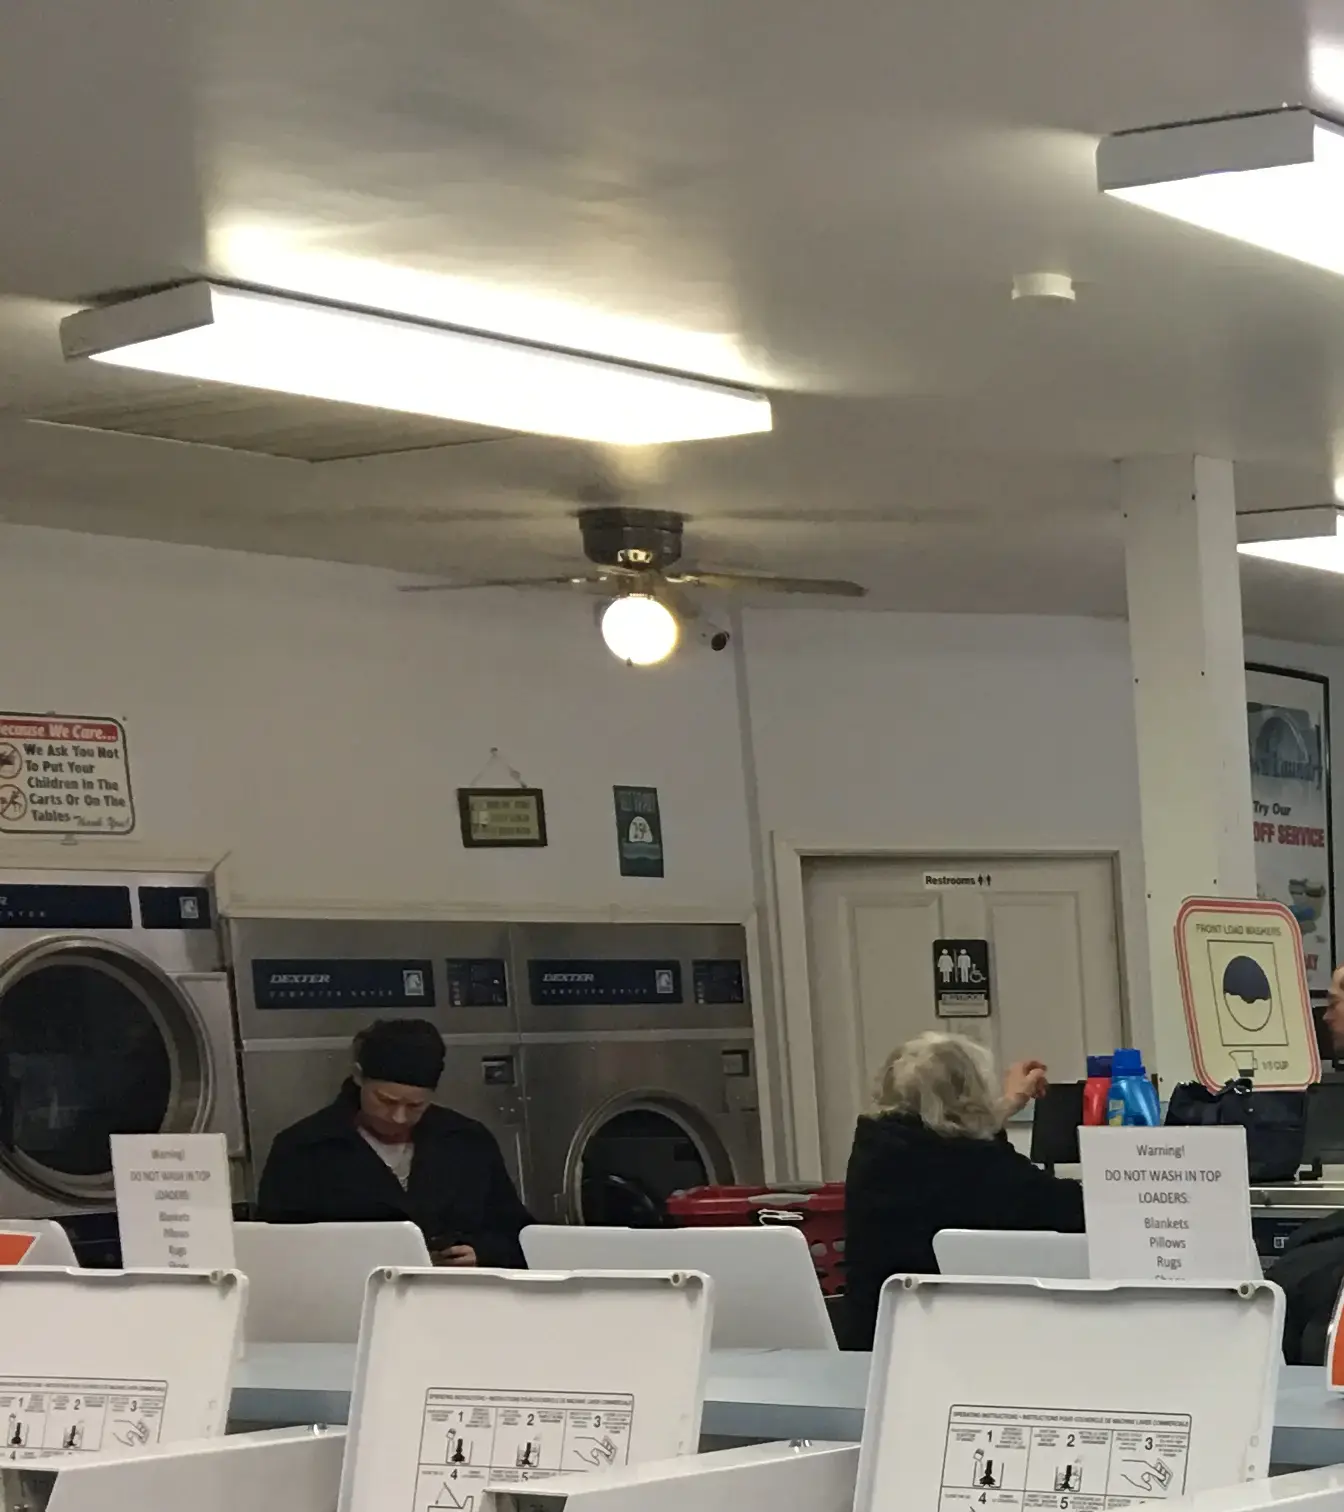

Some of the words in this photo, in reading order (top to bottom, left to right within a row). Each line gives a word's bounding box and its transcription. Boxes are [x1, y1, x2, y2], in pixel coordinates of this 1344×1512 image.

[0, 724, 45, 737] ecause
[48, 723, 70, 738] We
[23, 743, 43, 756] We
[47, 744, 68, 757] Ask
[72, 745, 95, 758] You
[97, 746, 120, 759] Not
[25, 760, 39, 772] To
[42, 761, 64, 773] Put
[67, 761, 95, 774] Your
[27, 776, 79, 789] Children
[82, 779, 94, 790] In
[97, 779, 119, 791] The
[29, 793, 62, 805] Carts
[66, 794, 80, 806] Or
[84, 794, 100, 806] On
[104, 795, 126, 808] The
[1253, 801, 1269, 816] Try
[1272, 802, 1291, 816] Our
[32, 810, 71, 822] Tables
[1278, 824, 1325, 848] SERVICE
[926, 875, 976, 885] Restrooms
[269, 974, 330, 984] DEXTER
[543, 973, 594, 982] DEXTER
[1136, 1144, 1184, 1158] Warning!
[142, 1171, 159, 1181] NOT
[1105, 1170, 1121, 1181] DO
[1124, 1170, 1147, 1181] NOT
[1150, 1170, 1182, 1181] WASH
[1185, 1170, 1198, 1182] IN
[1199, 1170, 1222, 1182] TOP
[1144, 1217, 1189, 1229] Blankets
[1149, 1237, 1186, 1248] Pillows
[1157, 1256, 1182, 1269] Rugs
[987, 1430, 993, 1442] 1
[1066, 1434, 1075, 1447] 2
[1144, 1437, 1153, 1450] 3
[978, 1492, 987, 1504] 4
[1059, 1497, 1069, 1509] 5
